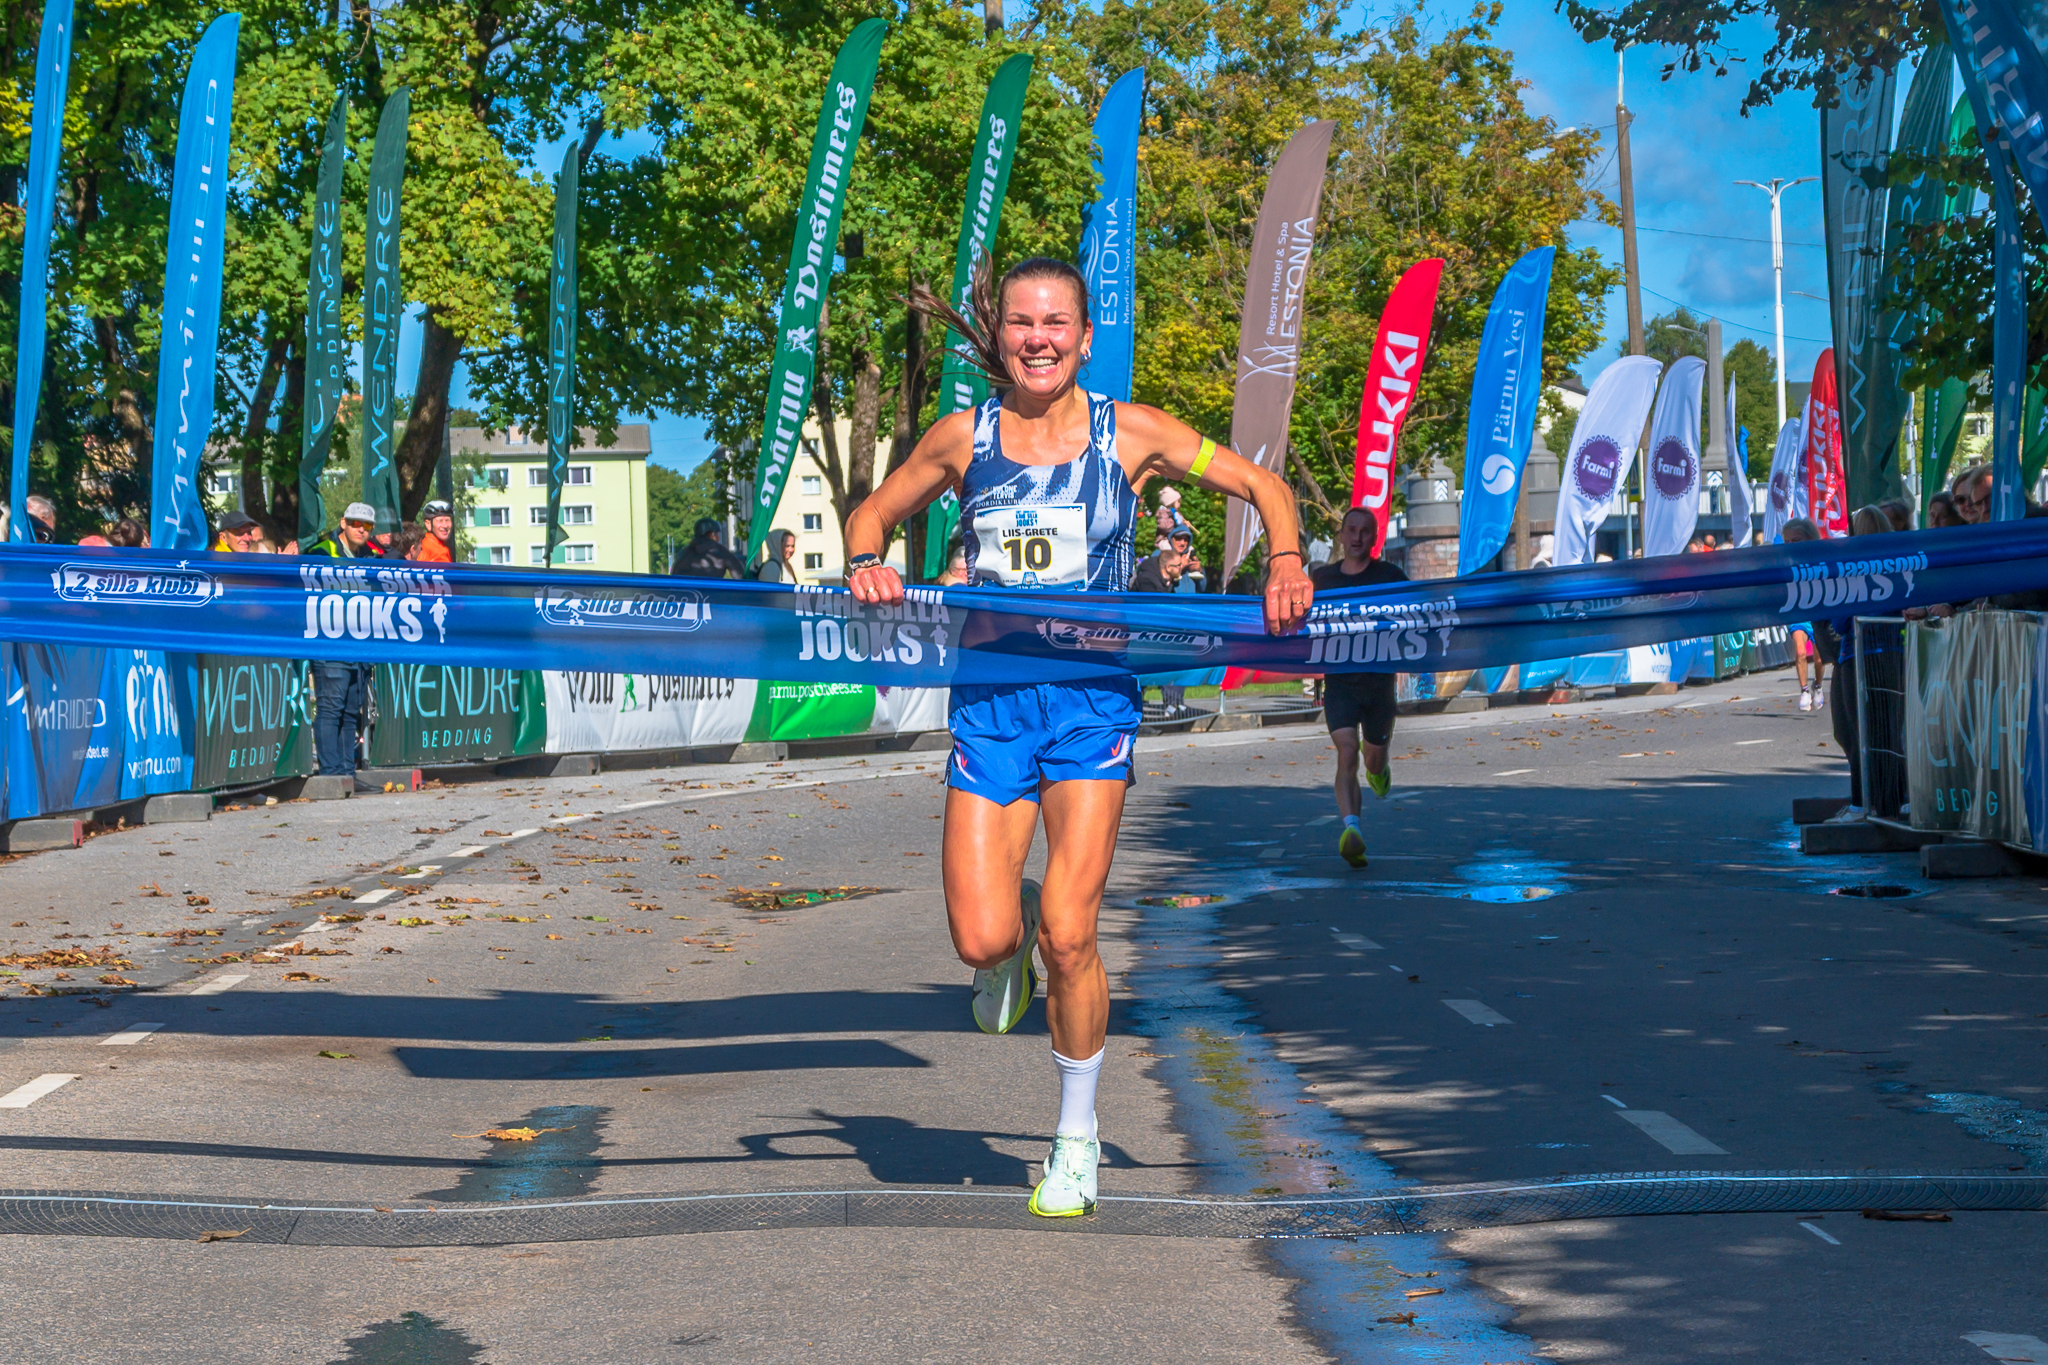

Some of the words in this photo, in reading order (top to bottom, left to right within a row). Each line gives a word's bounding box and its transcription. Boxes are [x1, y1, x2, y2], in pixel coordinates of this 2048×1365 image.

[794, 81, 857, 310] Postimees
[1278, 221, 1289, 244] Spa
[1100, 197, 1119, 326] ESTONIA
[1276, 248, 1285, 257] &
[1271, 260, 1283, 292] Hotel
[1280, 216, 1314, 338] ESTONIA
[371, 185, 393, 478] WENDRE
[1266, 295, 1279, 335] Resort
[1504, 309, 1525, 357] Vesi
[1362, 331, 1420, 508] UUKKI
[1492, 368, 1517, 443] Pärnu
[760, 369, 806, 508] Pärnu
[1582, 454, 1615, 479] Farmi
[1657, 457, 1688, 477] Farmi
[1002, 527, 1058, 538] LIIS-GRETE
[1003, 536, 1052, 571] 10
[72, 573, 91, 592] 2
[94, 573, 139, 593] silla
[143, 574, 200, 596] klubi
[300, 566, 372, 593] KAHE
[377, 570, 453, 598] SILLA
[303, 594, 423, 643] JOOKS
[555, 591, 574, 612] 2
[577, 590, 622, 615] silla
[627, 593, 689, 619] klubi
[795, 590, 866, 619] KAHE
[876, 600, 951, 625] SILLA
[798, 619, 923, 666] JOOKS
[1059, 625, 1079, 639] 2
[1083, 627, 1131, 641] silla
[1305, 628, 1429, 664] JOOKS
[387, 662, 520, 719] WENDRE
[421, 728, 492, 748] BEDDING
